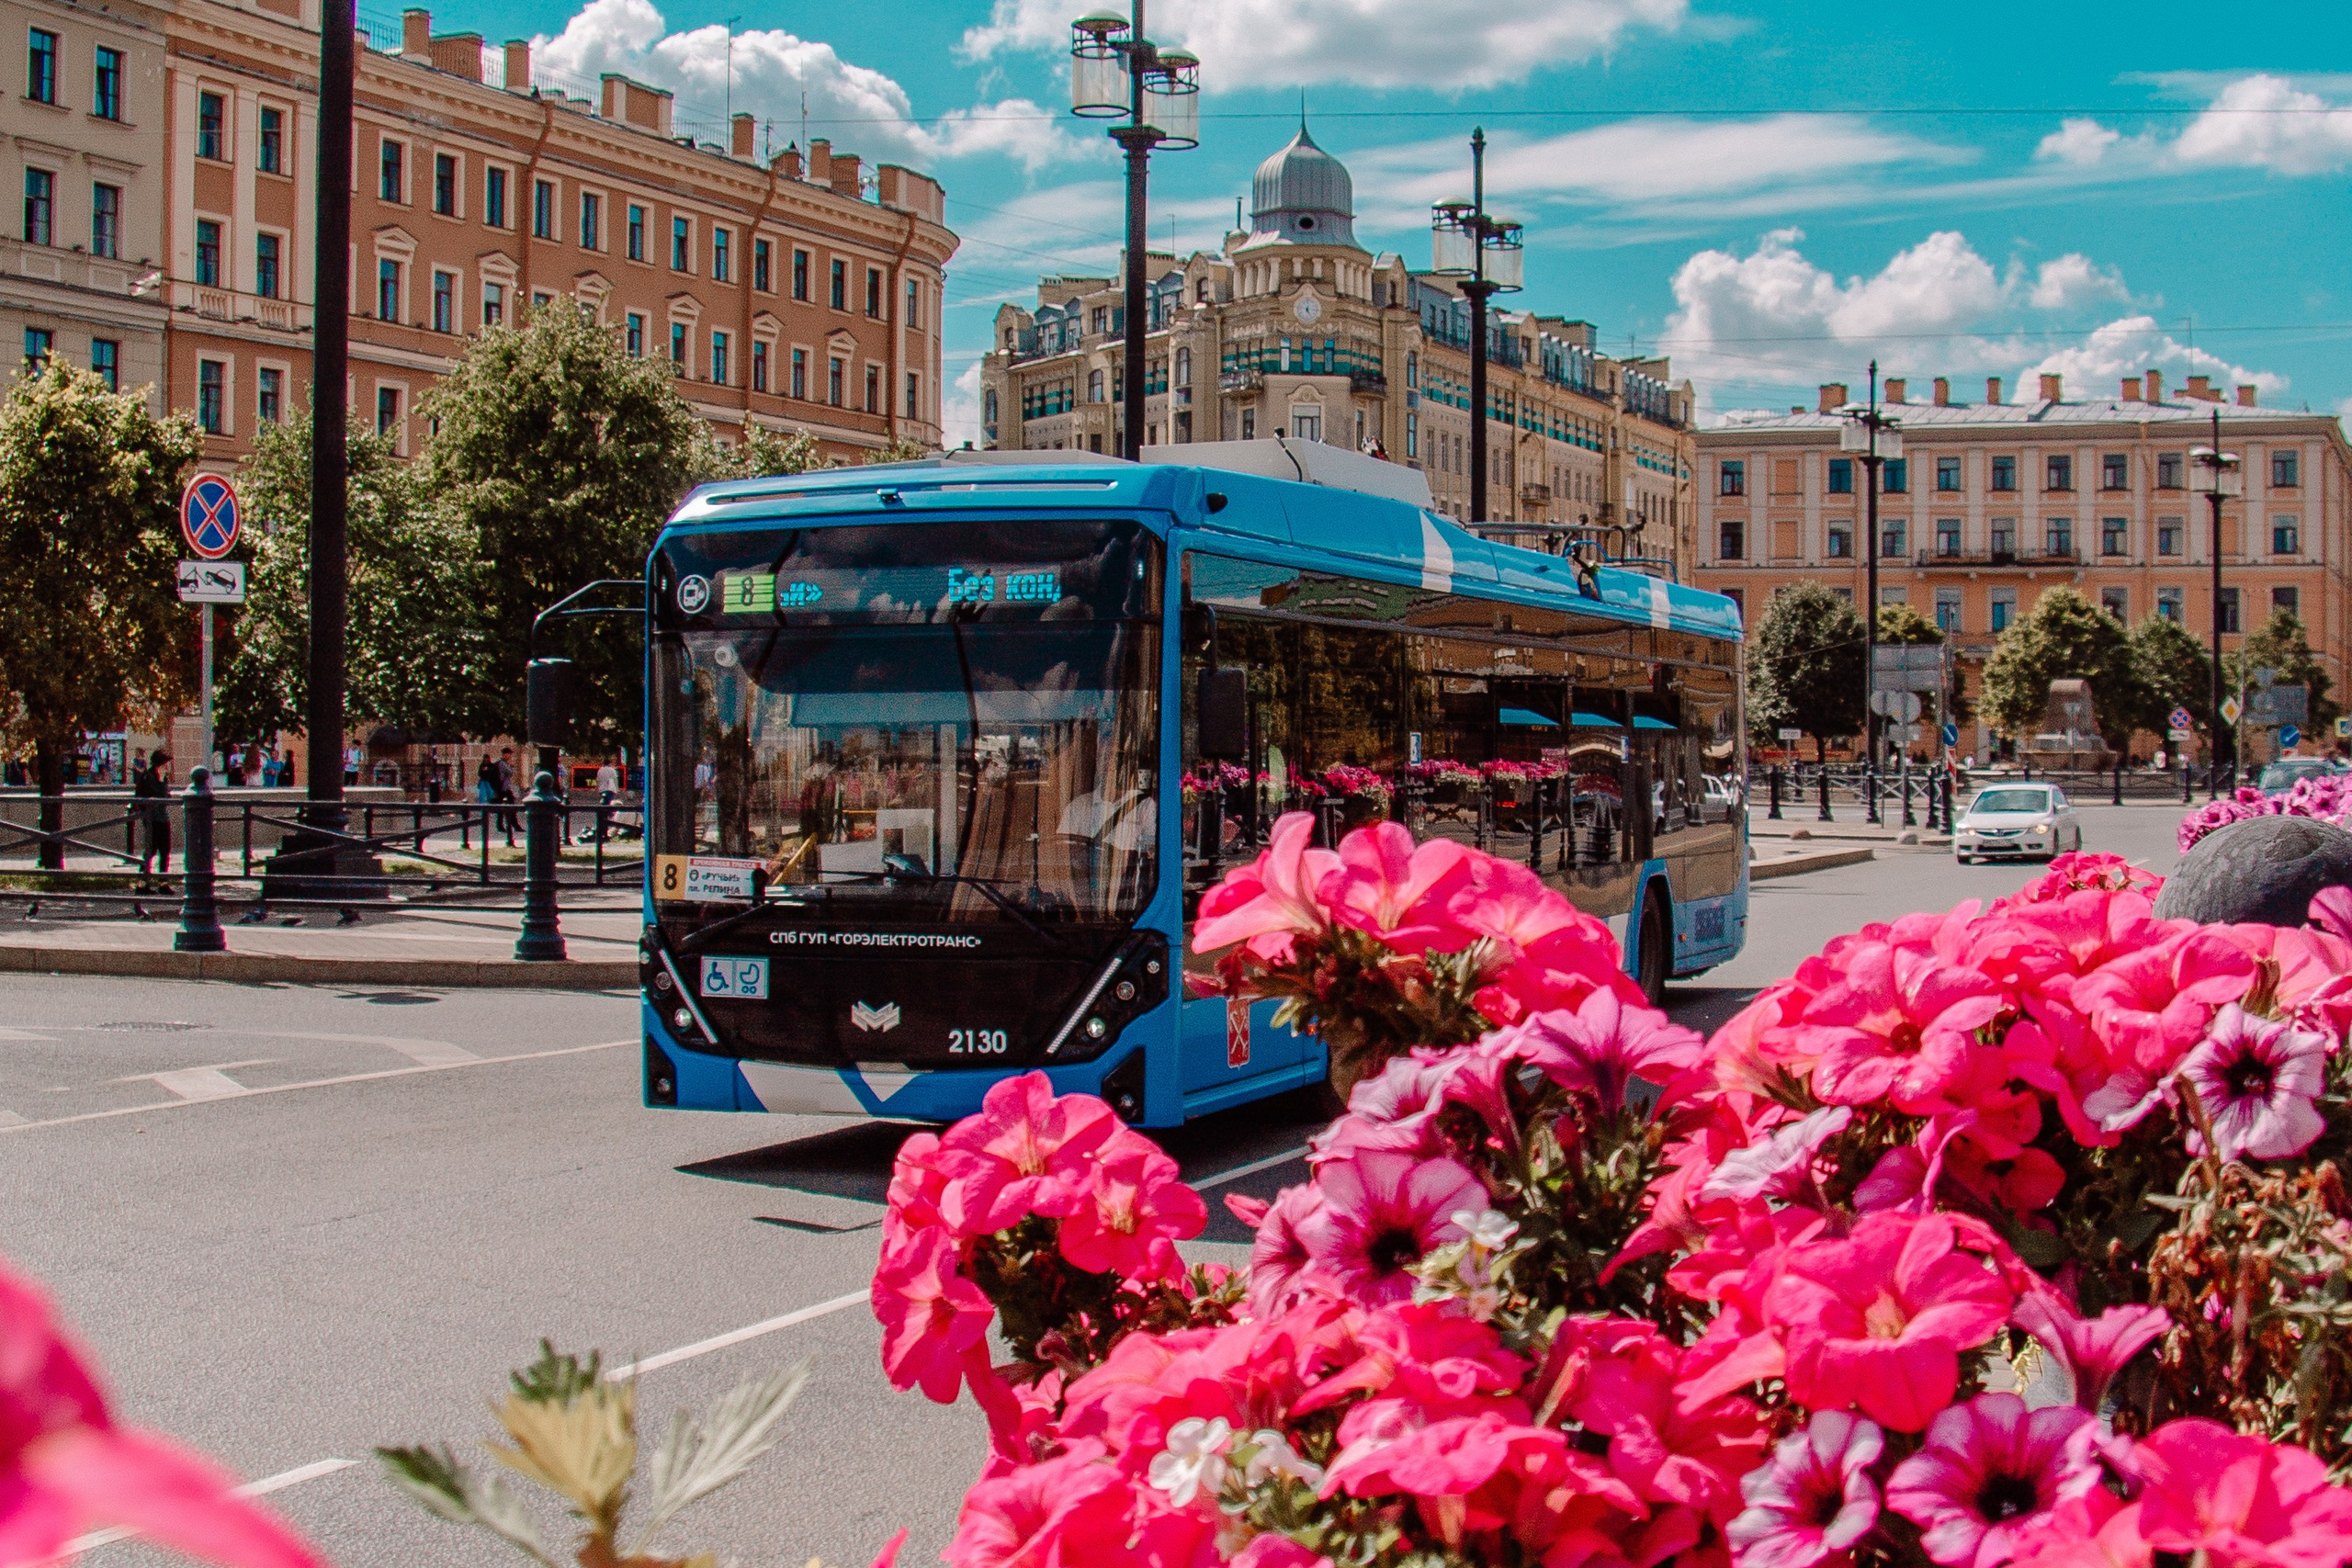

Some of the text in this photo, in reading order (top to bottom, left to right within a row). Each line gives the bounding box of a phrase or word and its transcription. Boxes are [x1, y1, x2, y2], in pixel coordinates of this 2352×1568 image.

[741, 576, 753, 606] 8
[948, 568, 995, 602] Без
[663, 863, 678, 891] 8
[703, 885, 741, 894] РЕПИНА
[770, 931, 981, 948] СПб ГУП «ГОРЭЛЕКТРОТРАНС»
[948, 1029, 1007, 1054] 2130
